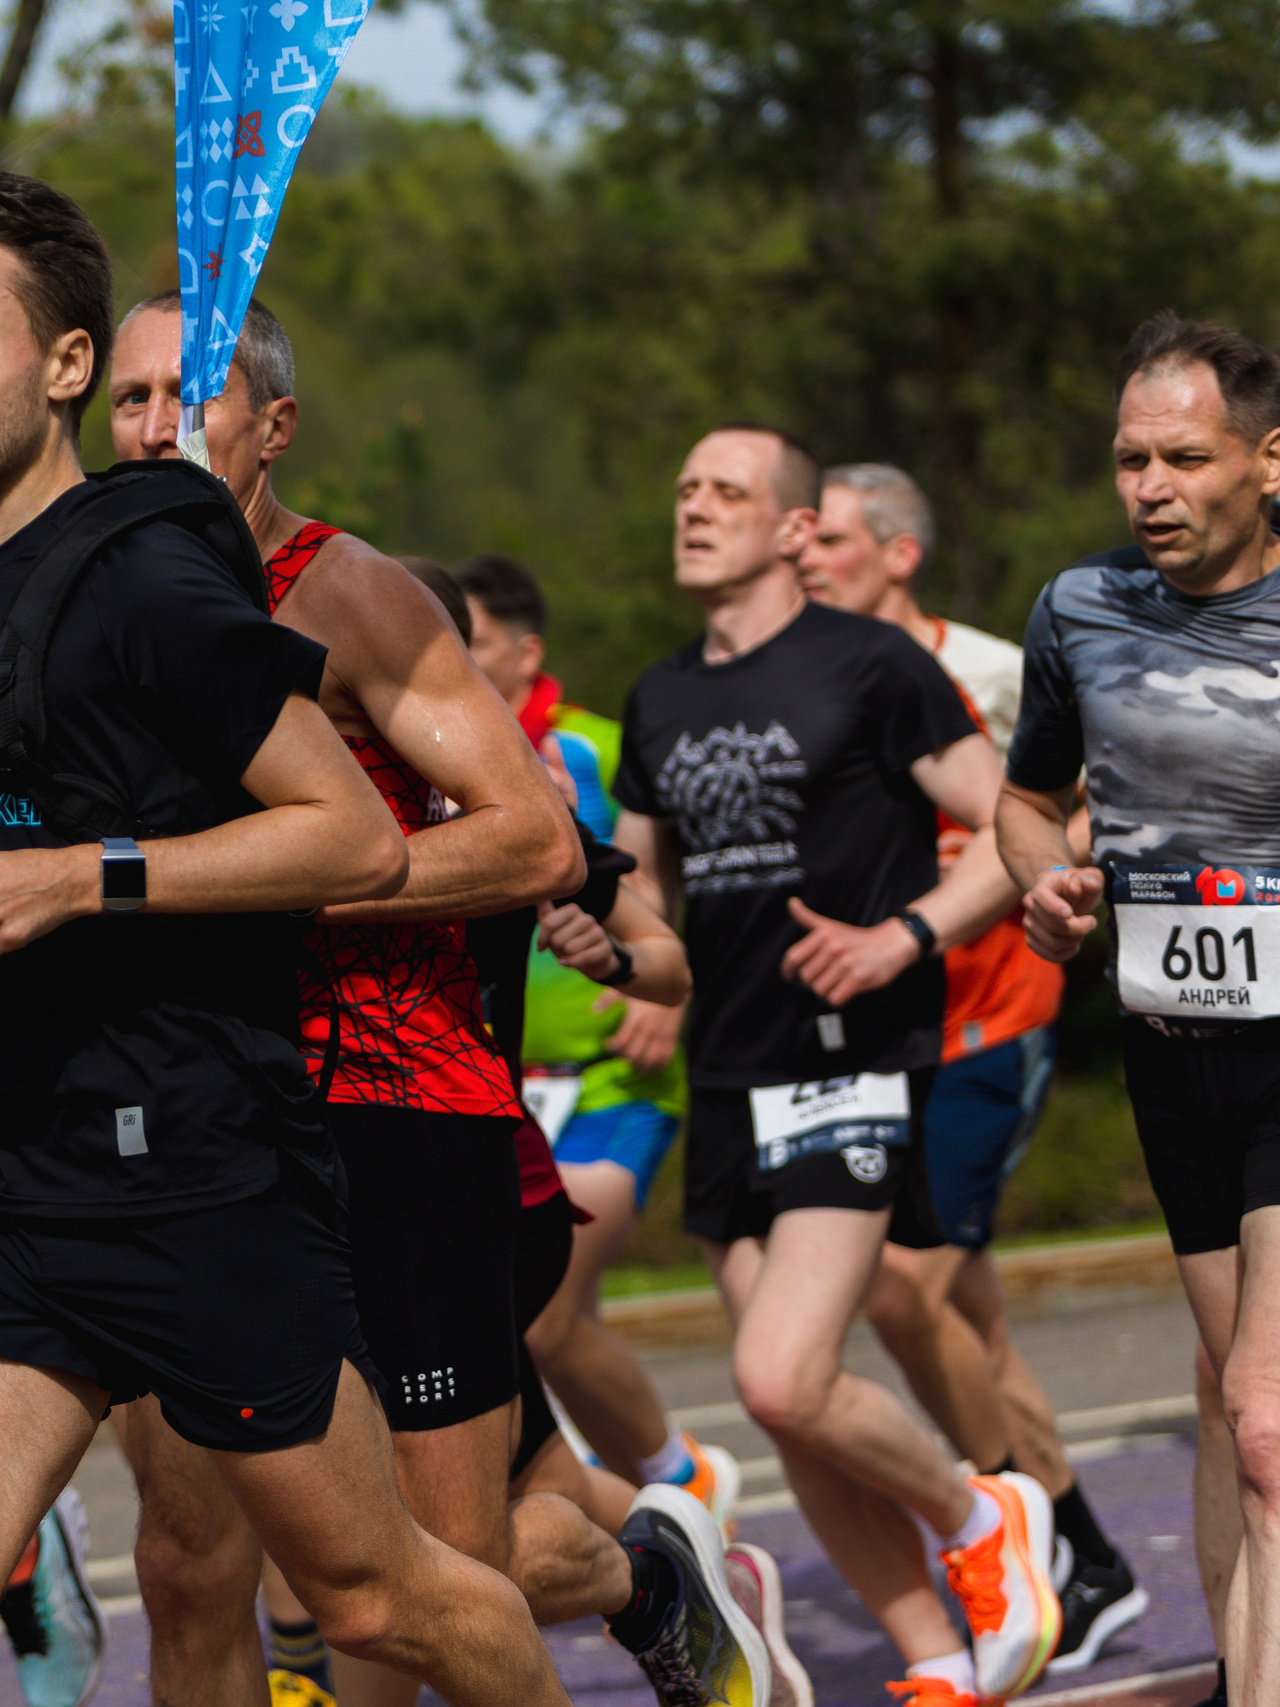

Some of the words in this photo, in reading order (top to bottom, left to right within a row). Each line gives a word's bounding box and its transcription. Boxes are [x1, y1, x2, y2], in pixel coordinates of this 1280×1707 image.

[1128, 871, 1191, 882] МОСКОВСКИЙ
[1161, 925, 1258, 982] 601
[1178, 986, 1251, 1007] АНДРЕЙ
[401, 1366, 454, 1384] COMP
[405, 1388, 456, 1405] PORT
